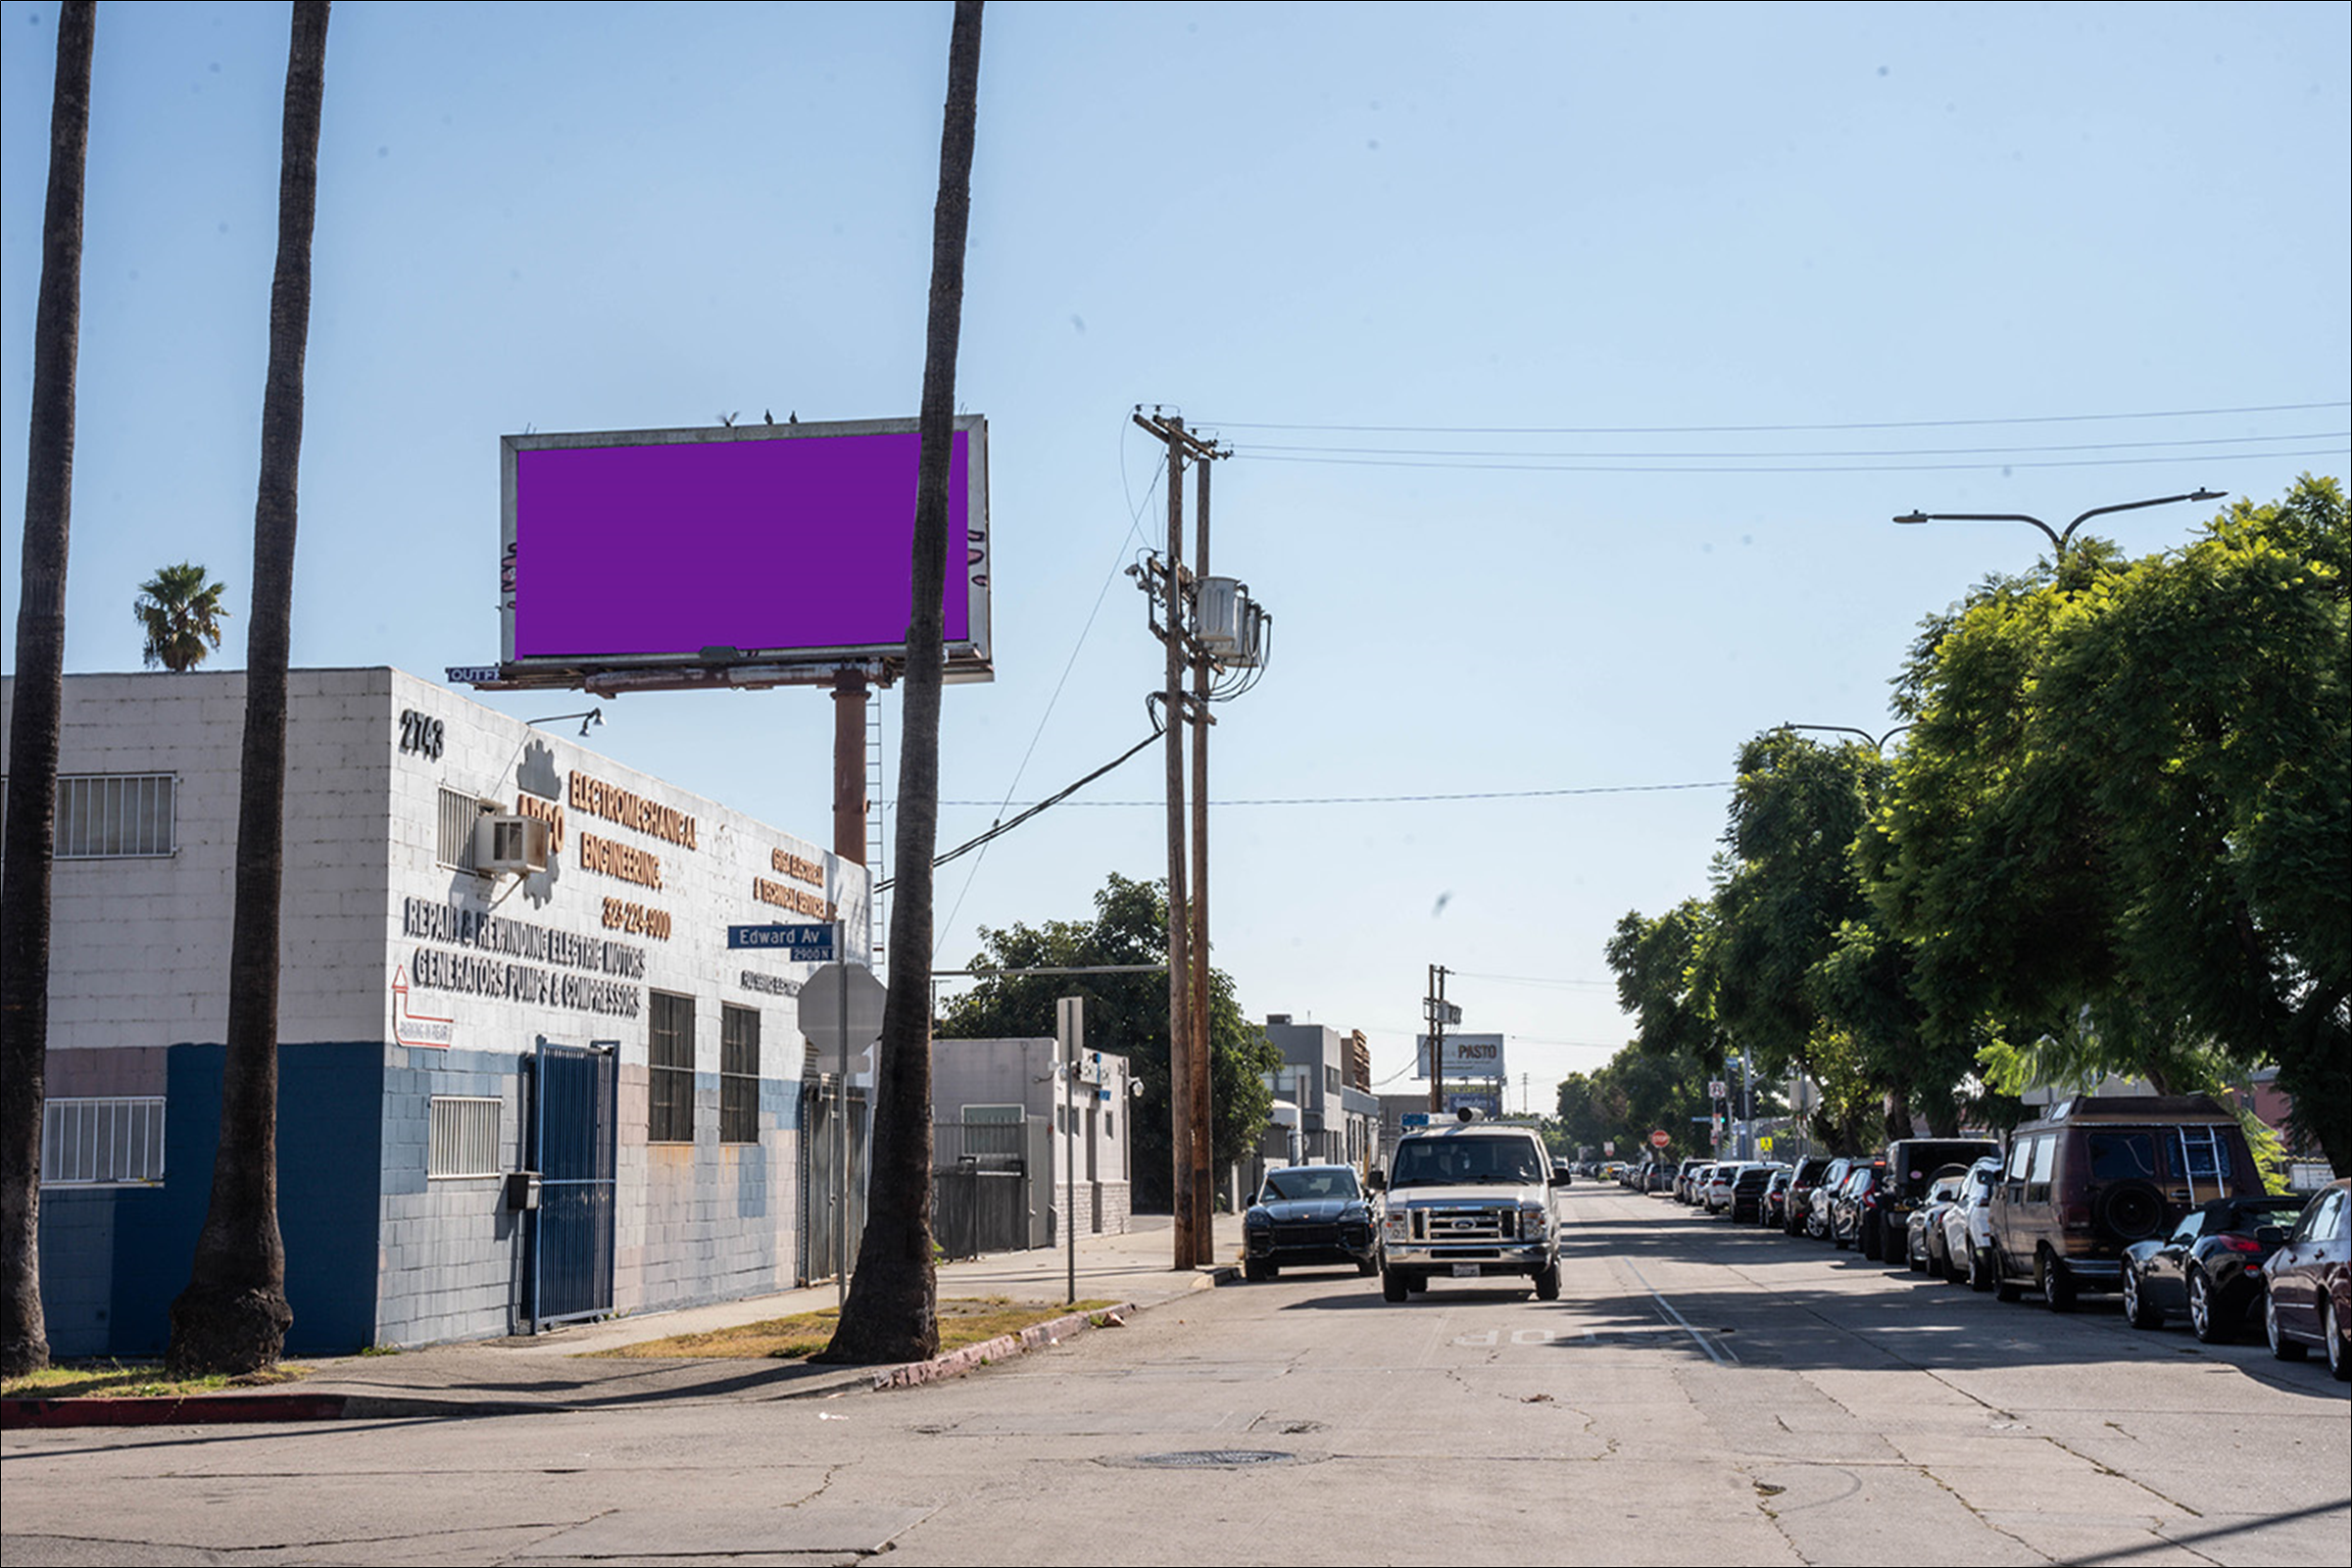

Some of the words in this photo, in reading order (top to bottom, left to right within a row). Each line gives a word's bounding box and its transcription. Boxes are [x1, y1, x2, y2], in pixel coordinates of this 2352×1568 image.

[399, 709, 444, 763] 2743
[569, 770, 698, 851] ELECTROMECHANICAL
[403, 896, 458, 945] REPAIR
[459, 909, 473, 948] &
[474, 911, 548, 959] REWINDING
[547, 928, 603, 971] ELECTRIC
[602, 940, 647, 980] MOTORS
[602, 897, 672, 942] 323-224-9000
[739, 928, 796, 945] Edward
[801, 929, 820, 944] Av
[793, 949, 820, 959] 2900
[821, 949, 830, 959] N
[549, 972, 562, 1007] &
[562, 972, 642, 1020] COMPRESSORS
[1457, 1044, 1497, 1059] PASTO
